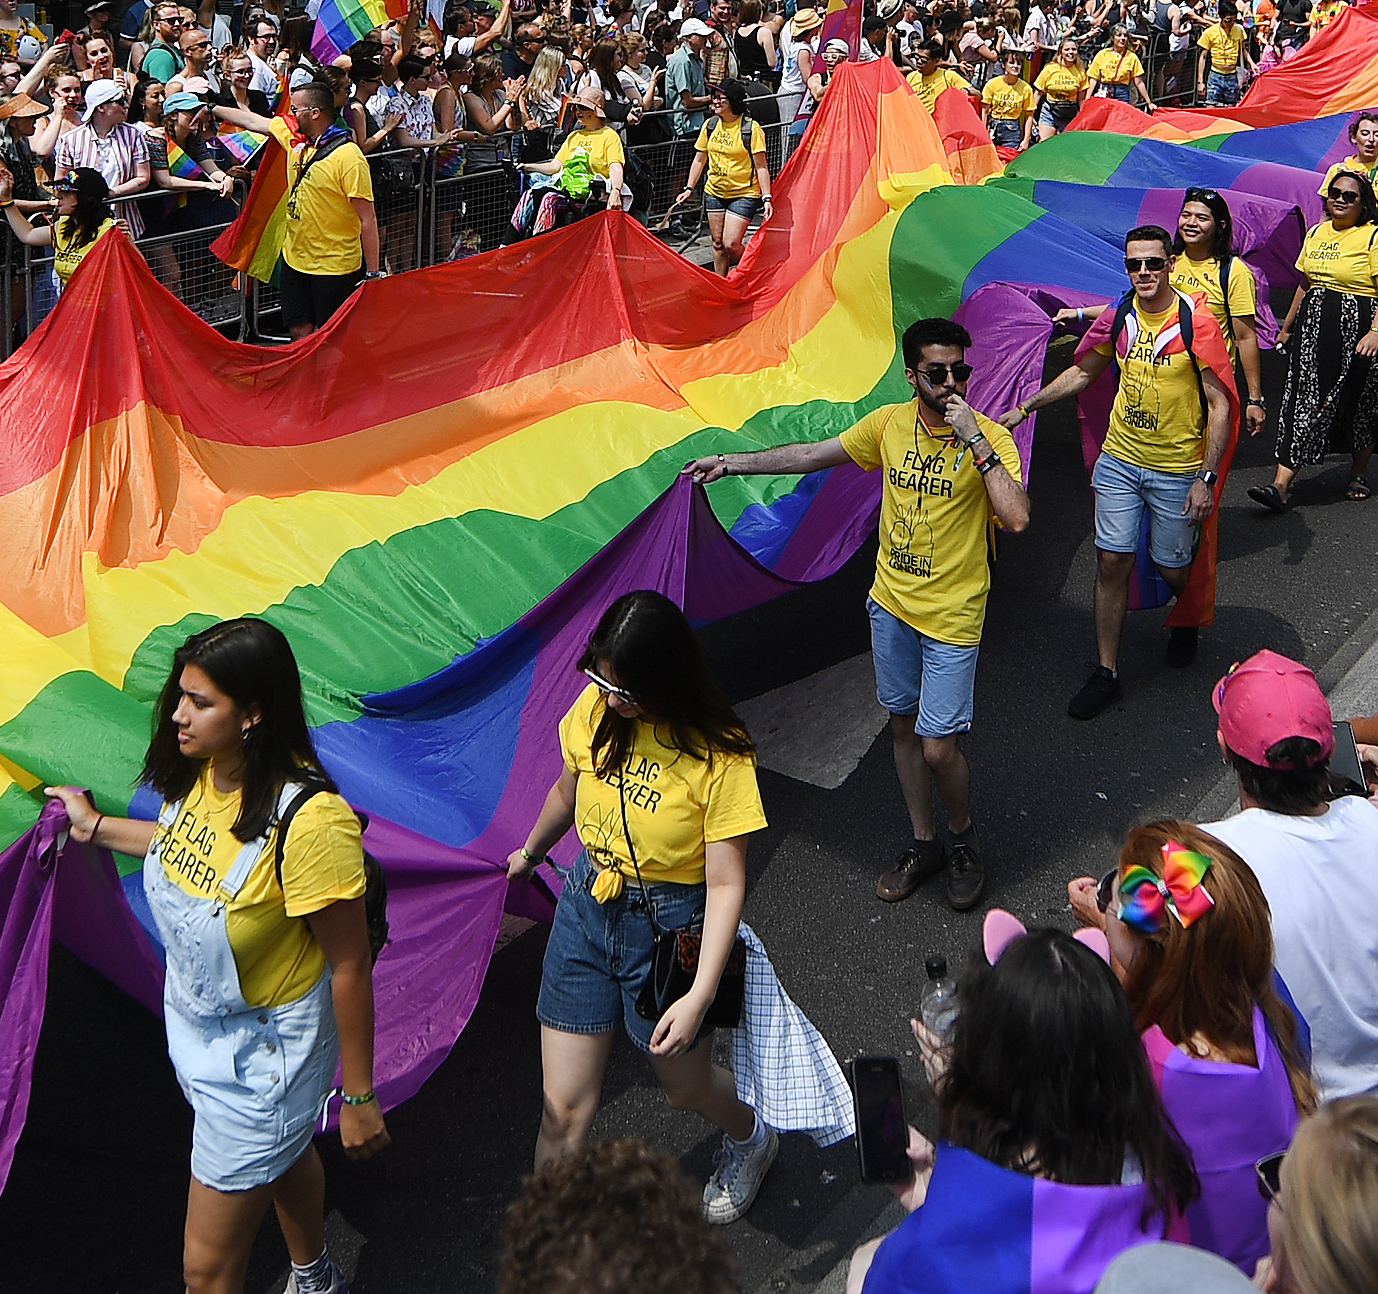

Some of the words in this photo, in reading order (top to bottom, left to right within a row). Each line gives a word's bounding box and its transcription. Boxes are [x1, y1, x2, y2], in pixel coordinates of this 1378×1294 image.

[1308, 251, 1341, 260] BEARER
[1127, 347, 1172, 368] EARER
[1124, 405, 1148, 420] PRIDE
[1123, 416, 1158, 432] LONDON
[902, 450, 946, 475] FLAG
[888, 467, 953, 498] BEARER
[888, 558, 931, 578] LONDON
[890, 547, 919, 567] PRIDE
[920, 556, 932, 568] IN
[625, 757, 661, 784] LAG
[177, 810, 216, 858] FLAG
[160, 831, 216, 894] BEARER
